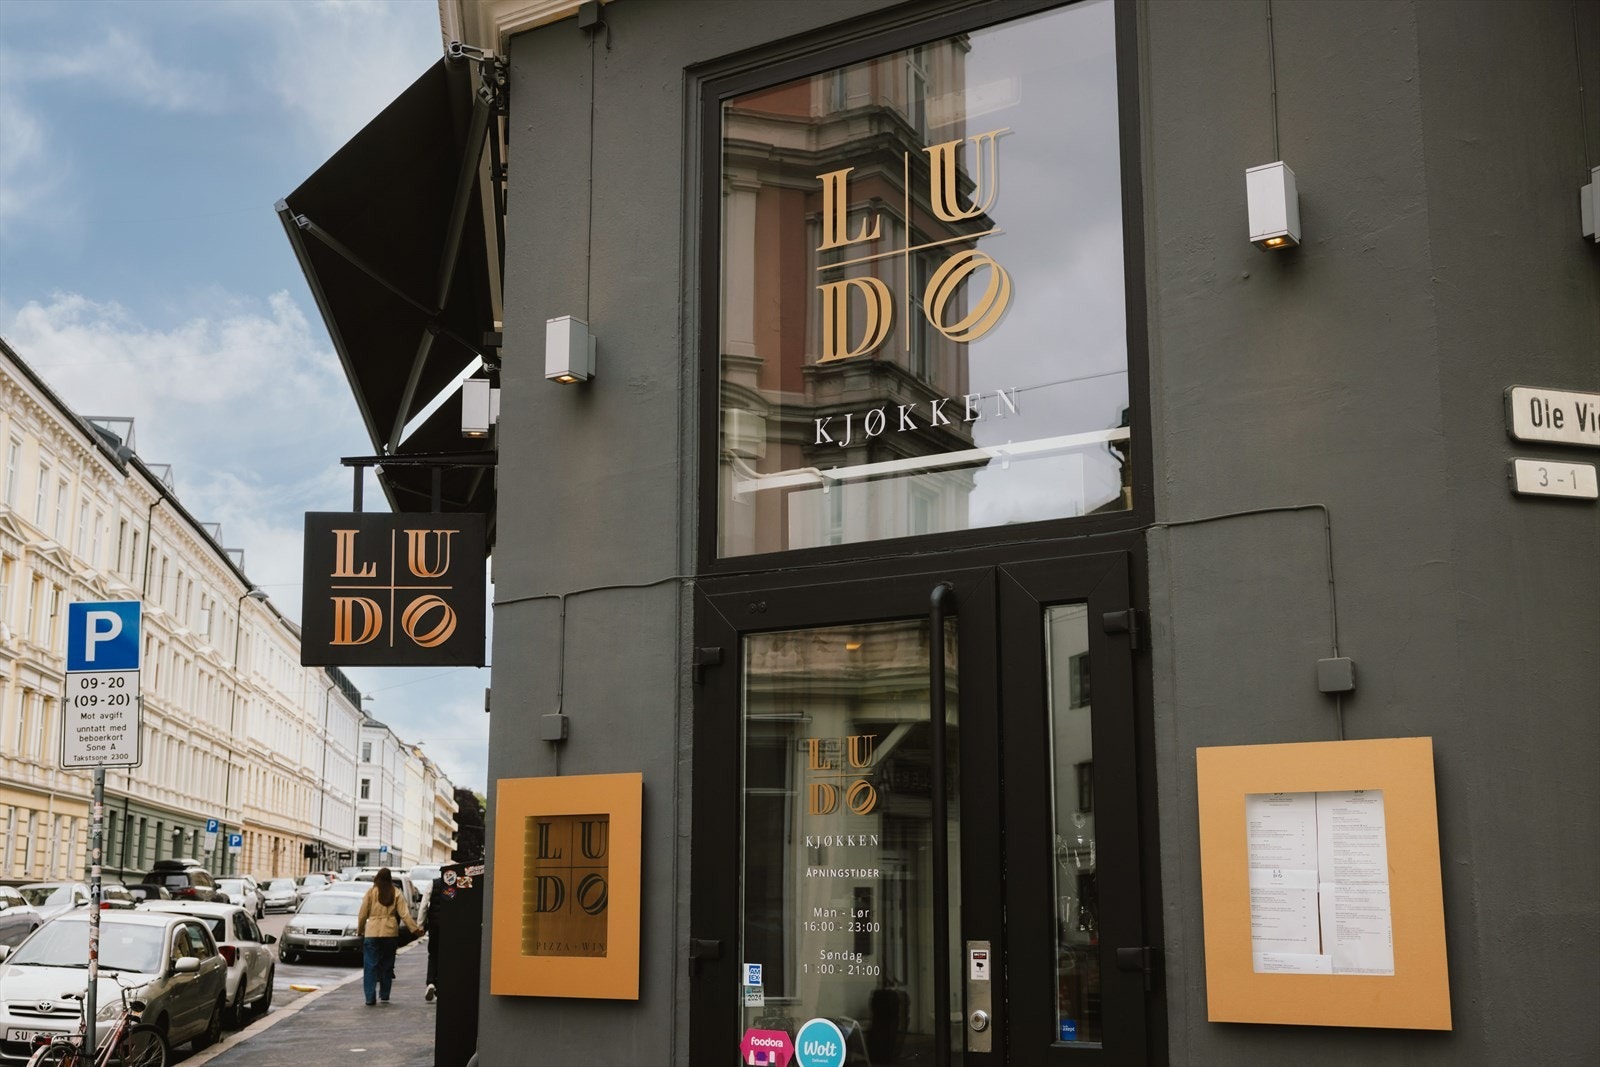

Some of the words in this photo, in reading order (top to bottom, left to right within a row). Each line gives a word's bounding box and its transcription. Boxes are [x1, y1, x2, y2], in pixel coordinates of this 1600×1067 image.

[814, 387, 1021, 448] KJØKKEN
[1530, 397, 1565, 429] Ole
[1575, 401, 1600, 433] Vi
[84, 611, 123, 662] P
[99, 711, 123, 720] avgift
[76, 725, 106, 733] unntatt
[109, 724, 127, 732] med
[79, 734, 123, 742] beboerkort
[86, 743, 106, 751] Sone
[805, 835, 879, 849] KJØKKEN
[813, 908, 837, 917] Man
[851, 908, 870, 918] Lør
[804, 921, 835, 932] 16:00
[848, 922, 880, 933] 23:00
[820, 949, 863, 964] Søndag
[803, 963, 835, 975] 1:00
[848, 964, 880, 976] 21:00
[751, 1036, 784, 1048] foodora
[804, 1040, 837, 1057] Wolt
